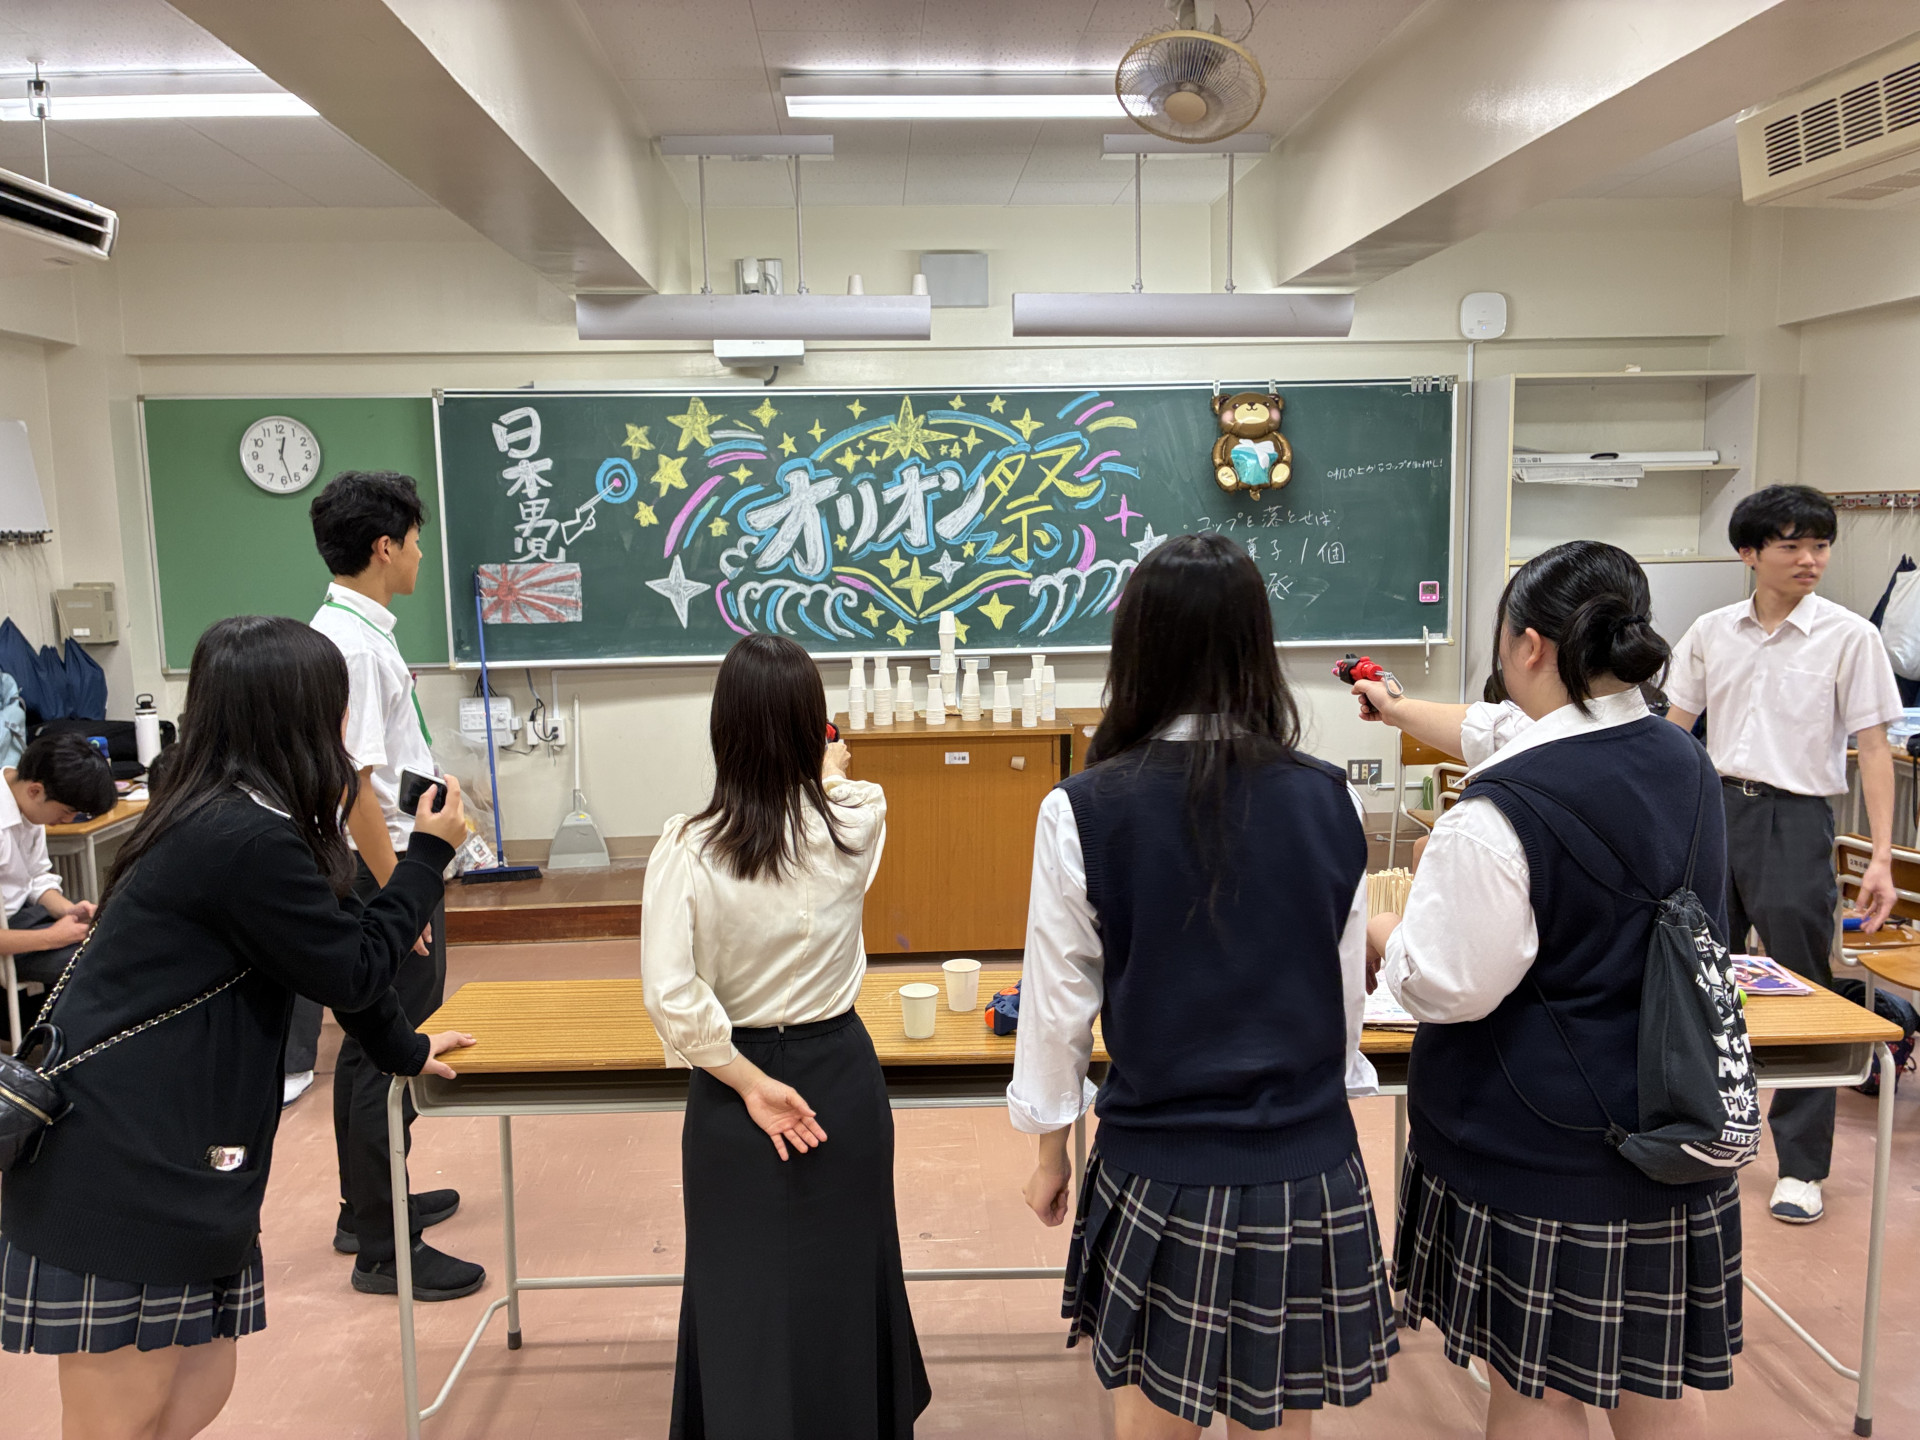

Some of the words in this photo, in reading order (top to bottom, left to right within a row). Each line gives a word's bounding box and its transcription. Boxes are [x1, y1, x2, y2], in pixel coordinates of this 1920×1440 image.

[262, 427, 271, 438] 11
[275, 424, 285, 434] 12
[291, 427, 296, 438] 1
[253, 438, 264, 449] 10
[300, 436, 308, 447] 2
[251, 450, 259, 461] 9
[304, 449, 312, 460] 3
[256, 463, 265, 474] 8
[301, 463, 309, 473] 4
[268, 472, 275, 482] 7
[280, 475, 288, 486] 6
[293, 472, 301, 482] 5
[492, 406, 566, 563] 日本男児
[746, 443, 1102, 576] オリオン祭
